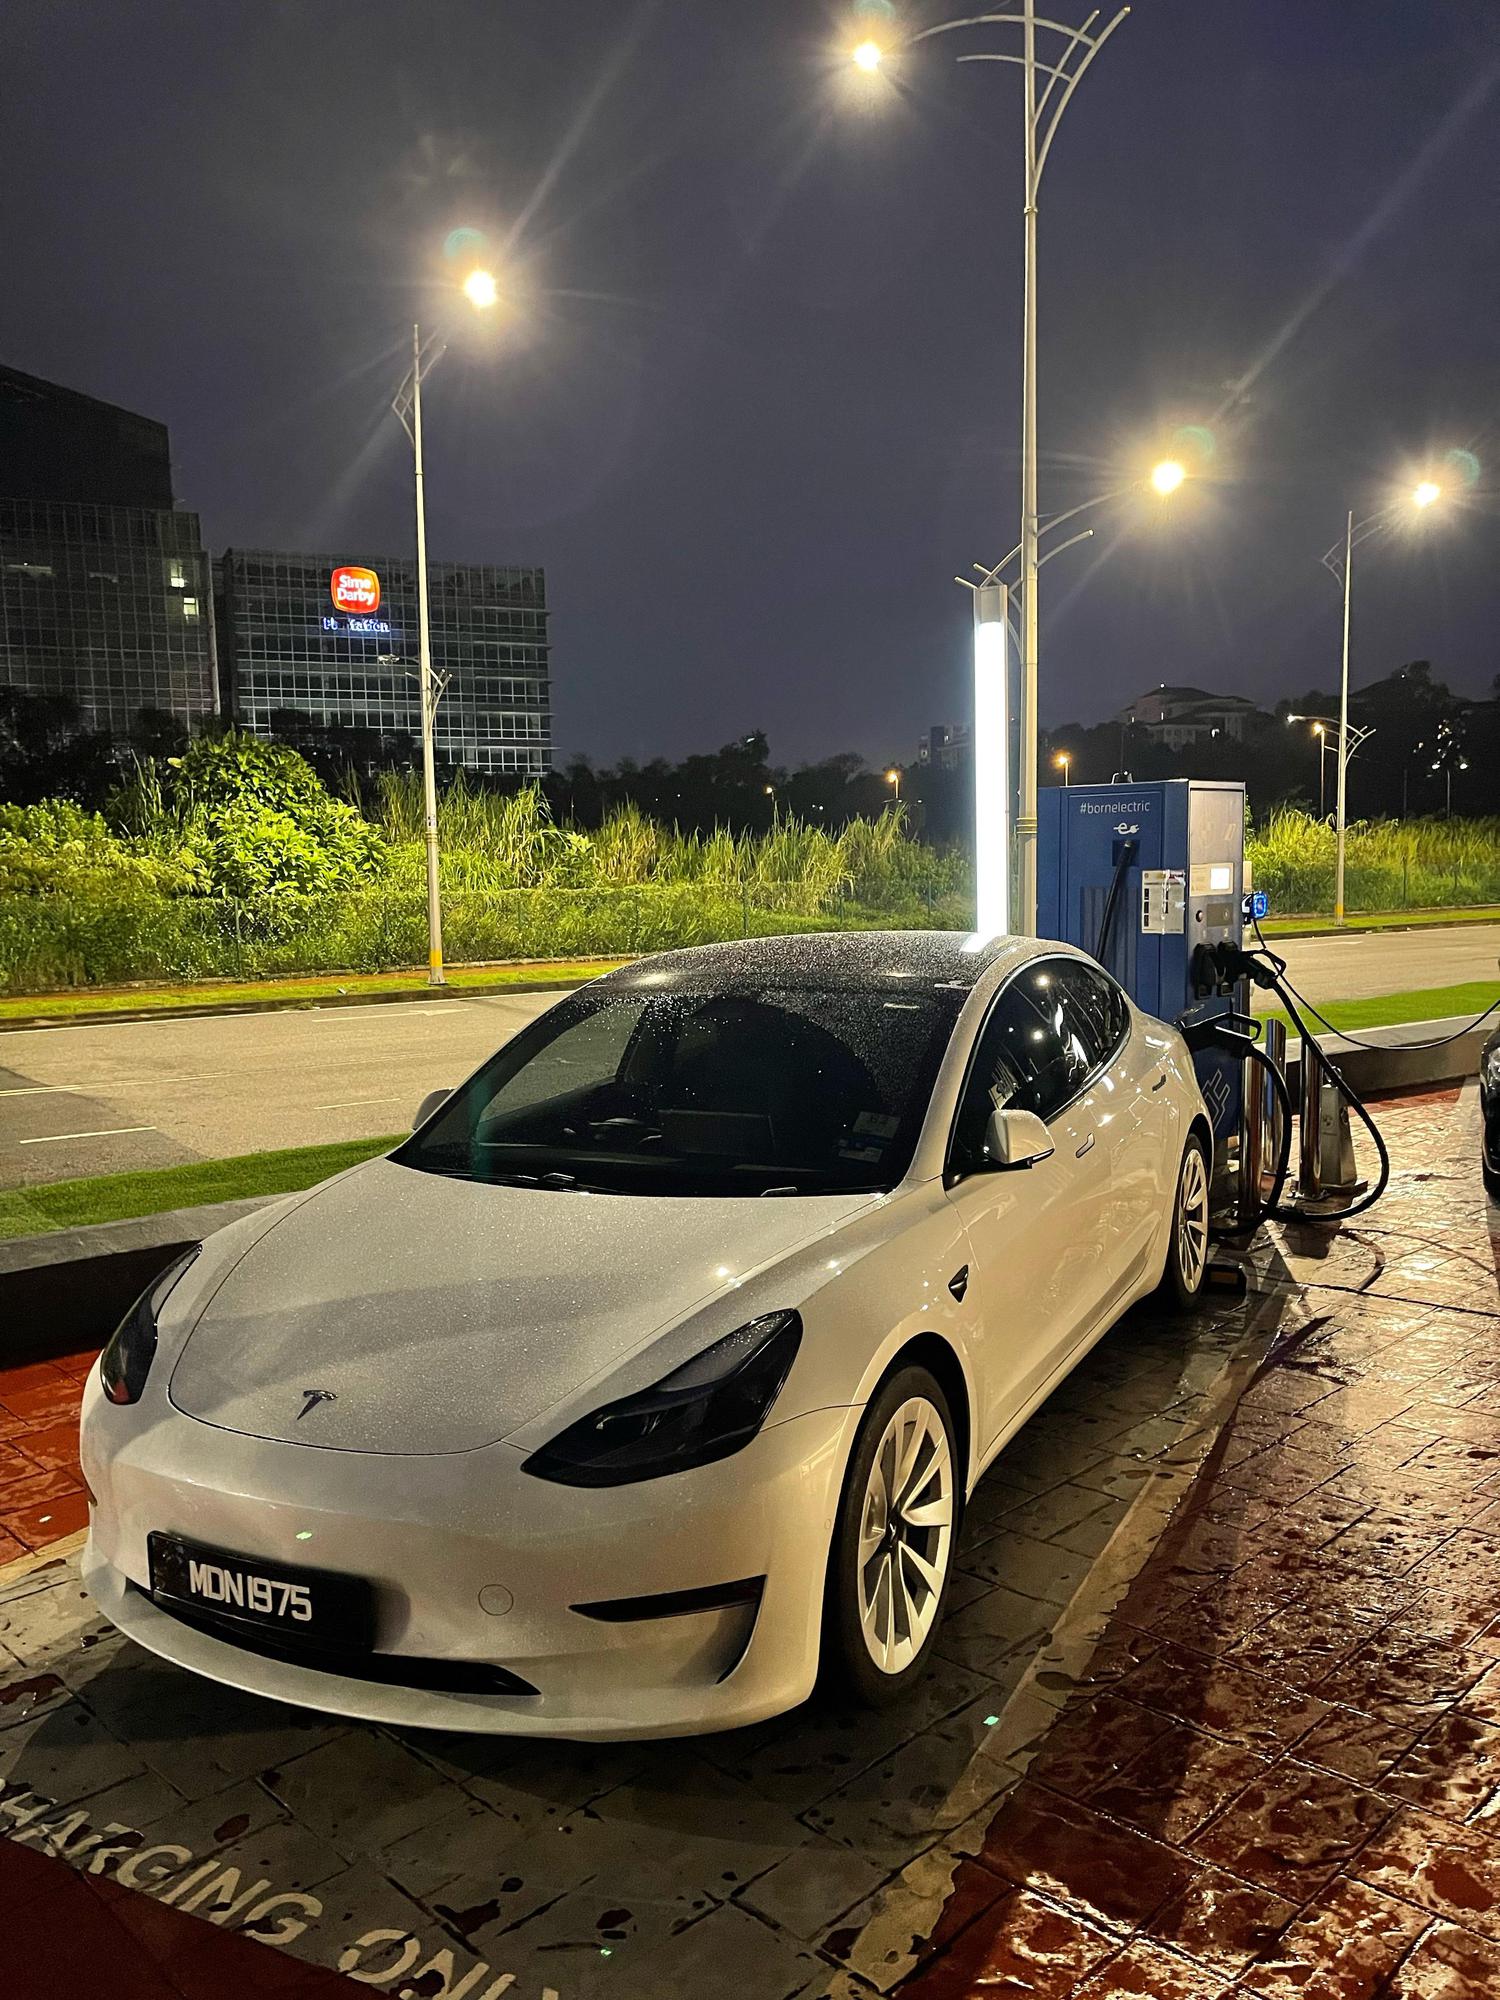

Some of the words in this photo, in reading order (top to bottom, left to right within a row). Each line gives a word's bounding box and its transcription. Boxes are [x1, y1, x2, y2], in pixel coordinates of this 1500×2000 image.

[339, 574, 371, 589] Sime
[337, 588, 375, 606] Darby
[1079, 800, 1150, 814] #bornelectric
[0, 1778, 324, 1946] HARGING
[337, 1928, 561, 2000] ON
